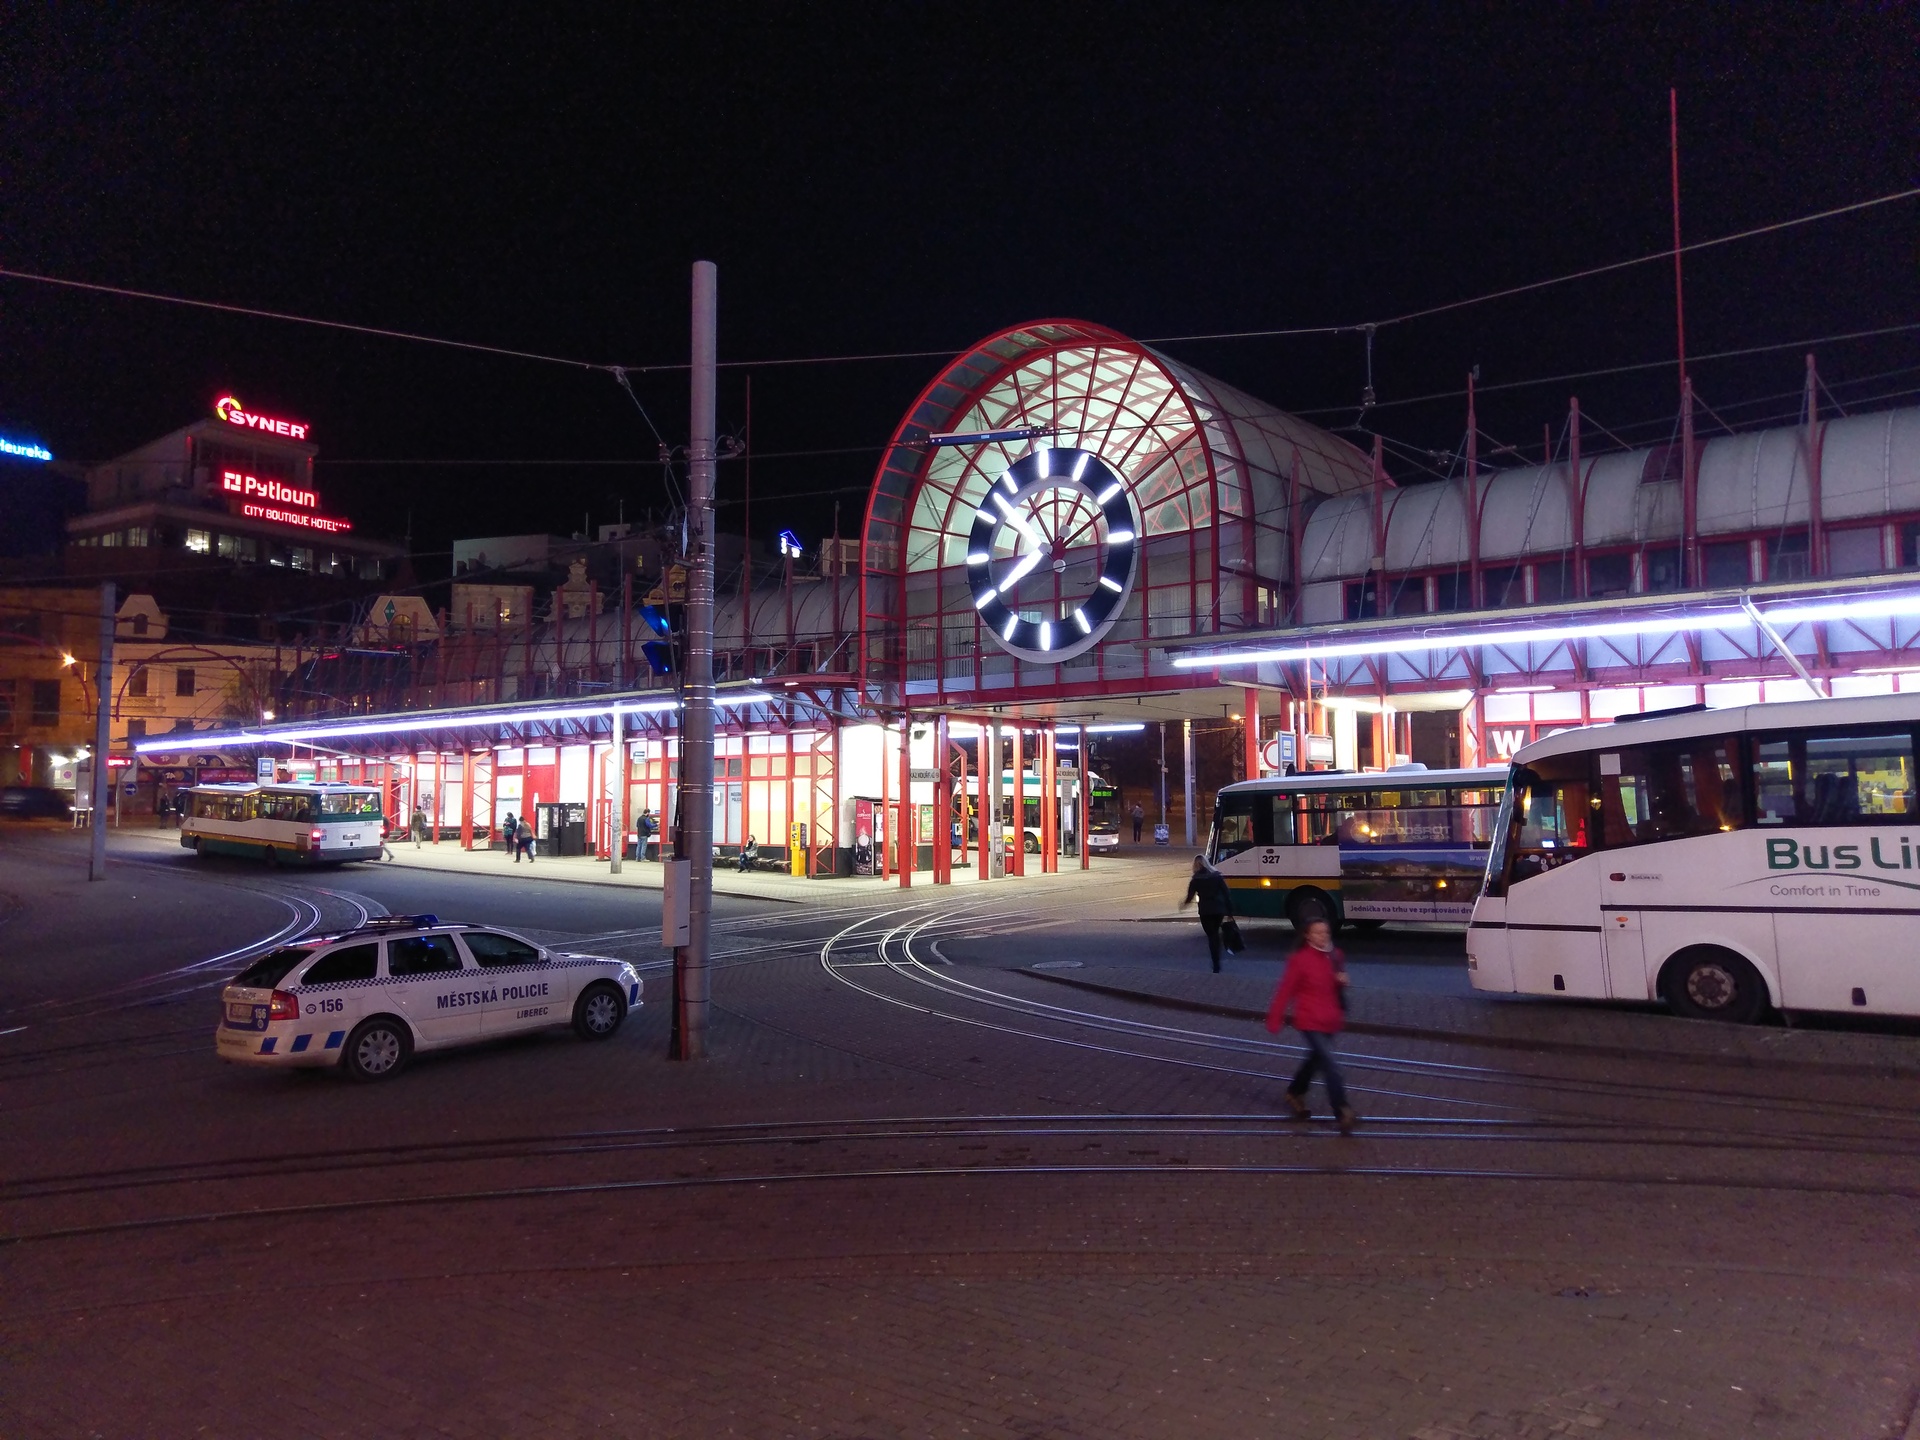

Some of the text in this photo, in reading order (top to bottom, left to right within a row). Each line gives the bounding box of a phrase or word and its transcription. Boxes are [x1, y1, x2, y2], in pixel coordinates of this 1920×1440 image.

[229, 409, 305, 439] SYNER
[245, 476, 315, 507] Pytloun
[245, 505, 264, 517] CITY
[266, 509, 309, 526] BOUTIQUE
[362, 804, 372, 813] 22
[1262, 855, 1280, 864] 327
[1770, 884, 1881, 897] Comfort in Time
[1350, 905, 1380, 913] Jednička
[1419, 906, 1460, 915] zpracování
[437, 983, 549, 1009] MĚSTSKÁ POLICIE
[320, 999, 343, 1012] 156
[255, 1008, 267, 1019] 156
[516, 1007, 549, 1019] LIBEREC
